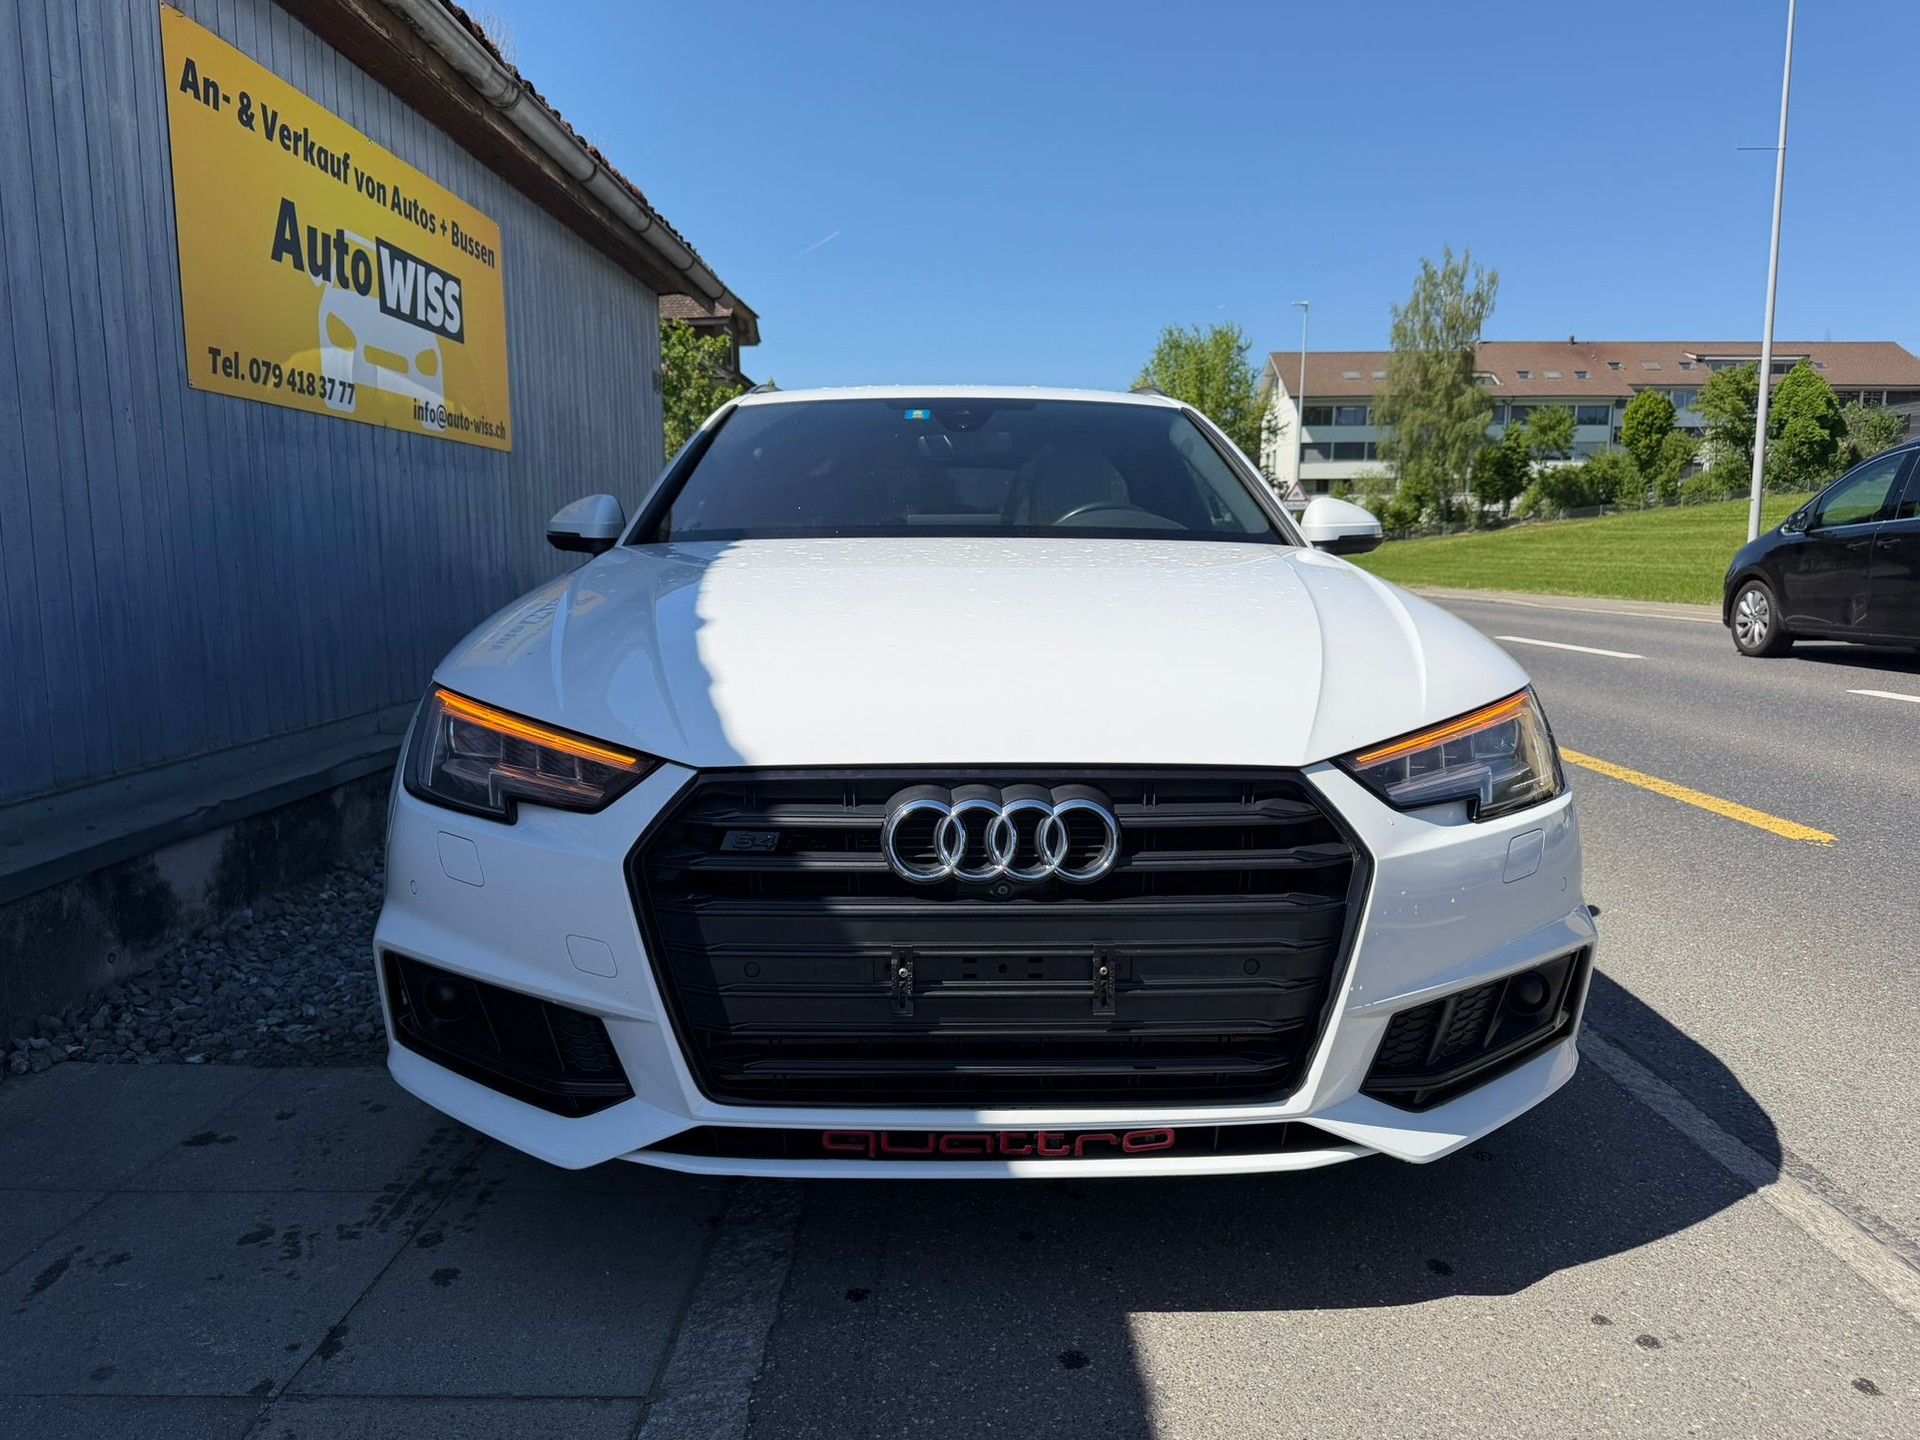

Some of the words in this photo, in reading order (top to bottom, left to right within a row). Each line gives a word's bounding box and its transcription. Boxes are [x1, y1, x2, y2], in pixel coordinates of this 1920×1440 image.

[180, 57, 231, 112] An-
[238, 91, 256, 132] &
[260, 102, 351, 184] Verkauf
[354, 167, 387, 208] von
[390, 186, 436, 235] Autos
[440, 218, 448, 236] +
[451, 220, 495, 269] Bussen
[271, 197, 373, 297] Auto
[380, 246, 461, 334] WISS
[208, 346, 245, 380] Tel.
[249, 358, 283, 388] 079
[286, 368, 316, 396] 418
[319, 376, 335, 400] 37
[339, 382, 355, 405] 77
[413, 398, 506, 440] info@auto-wiss.ch
[734, 835, 776, 850] S4
[821, 1127, 1175, 1157] quattro
